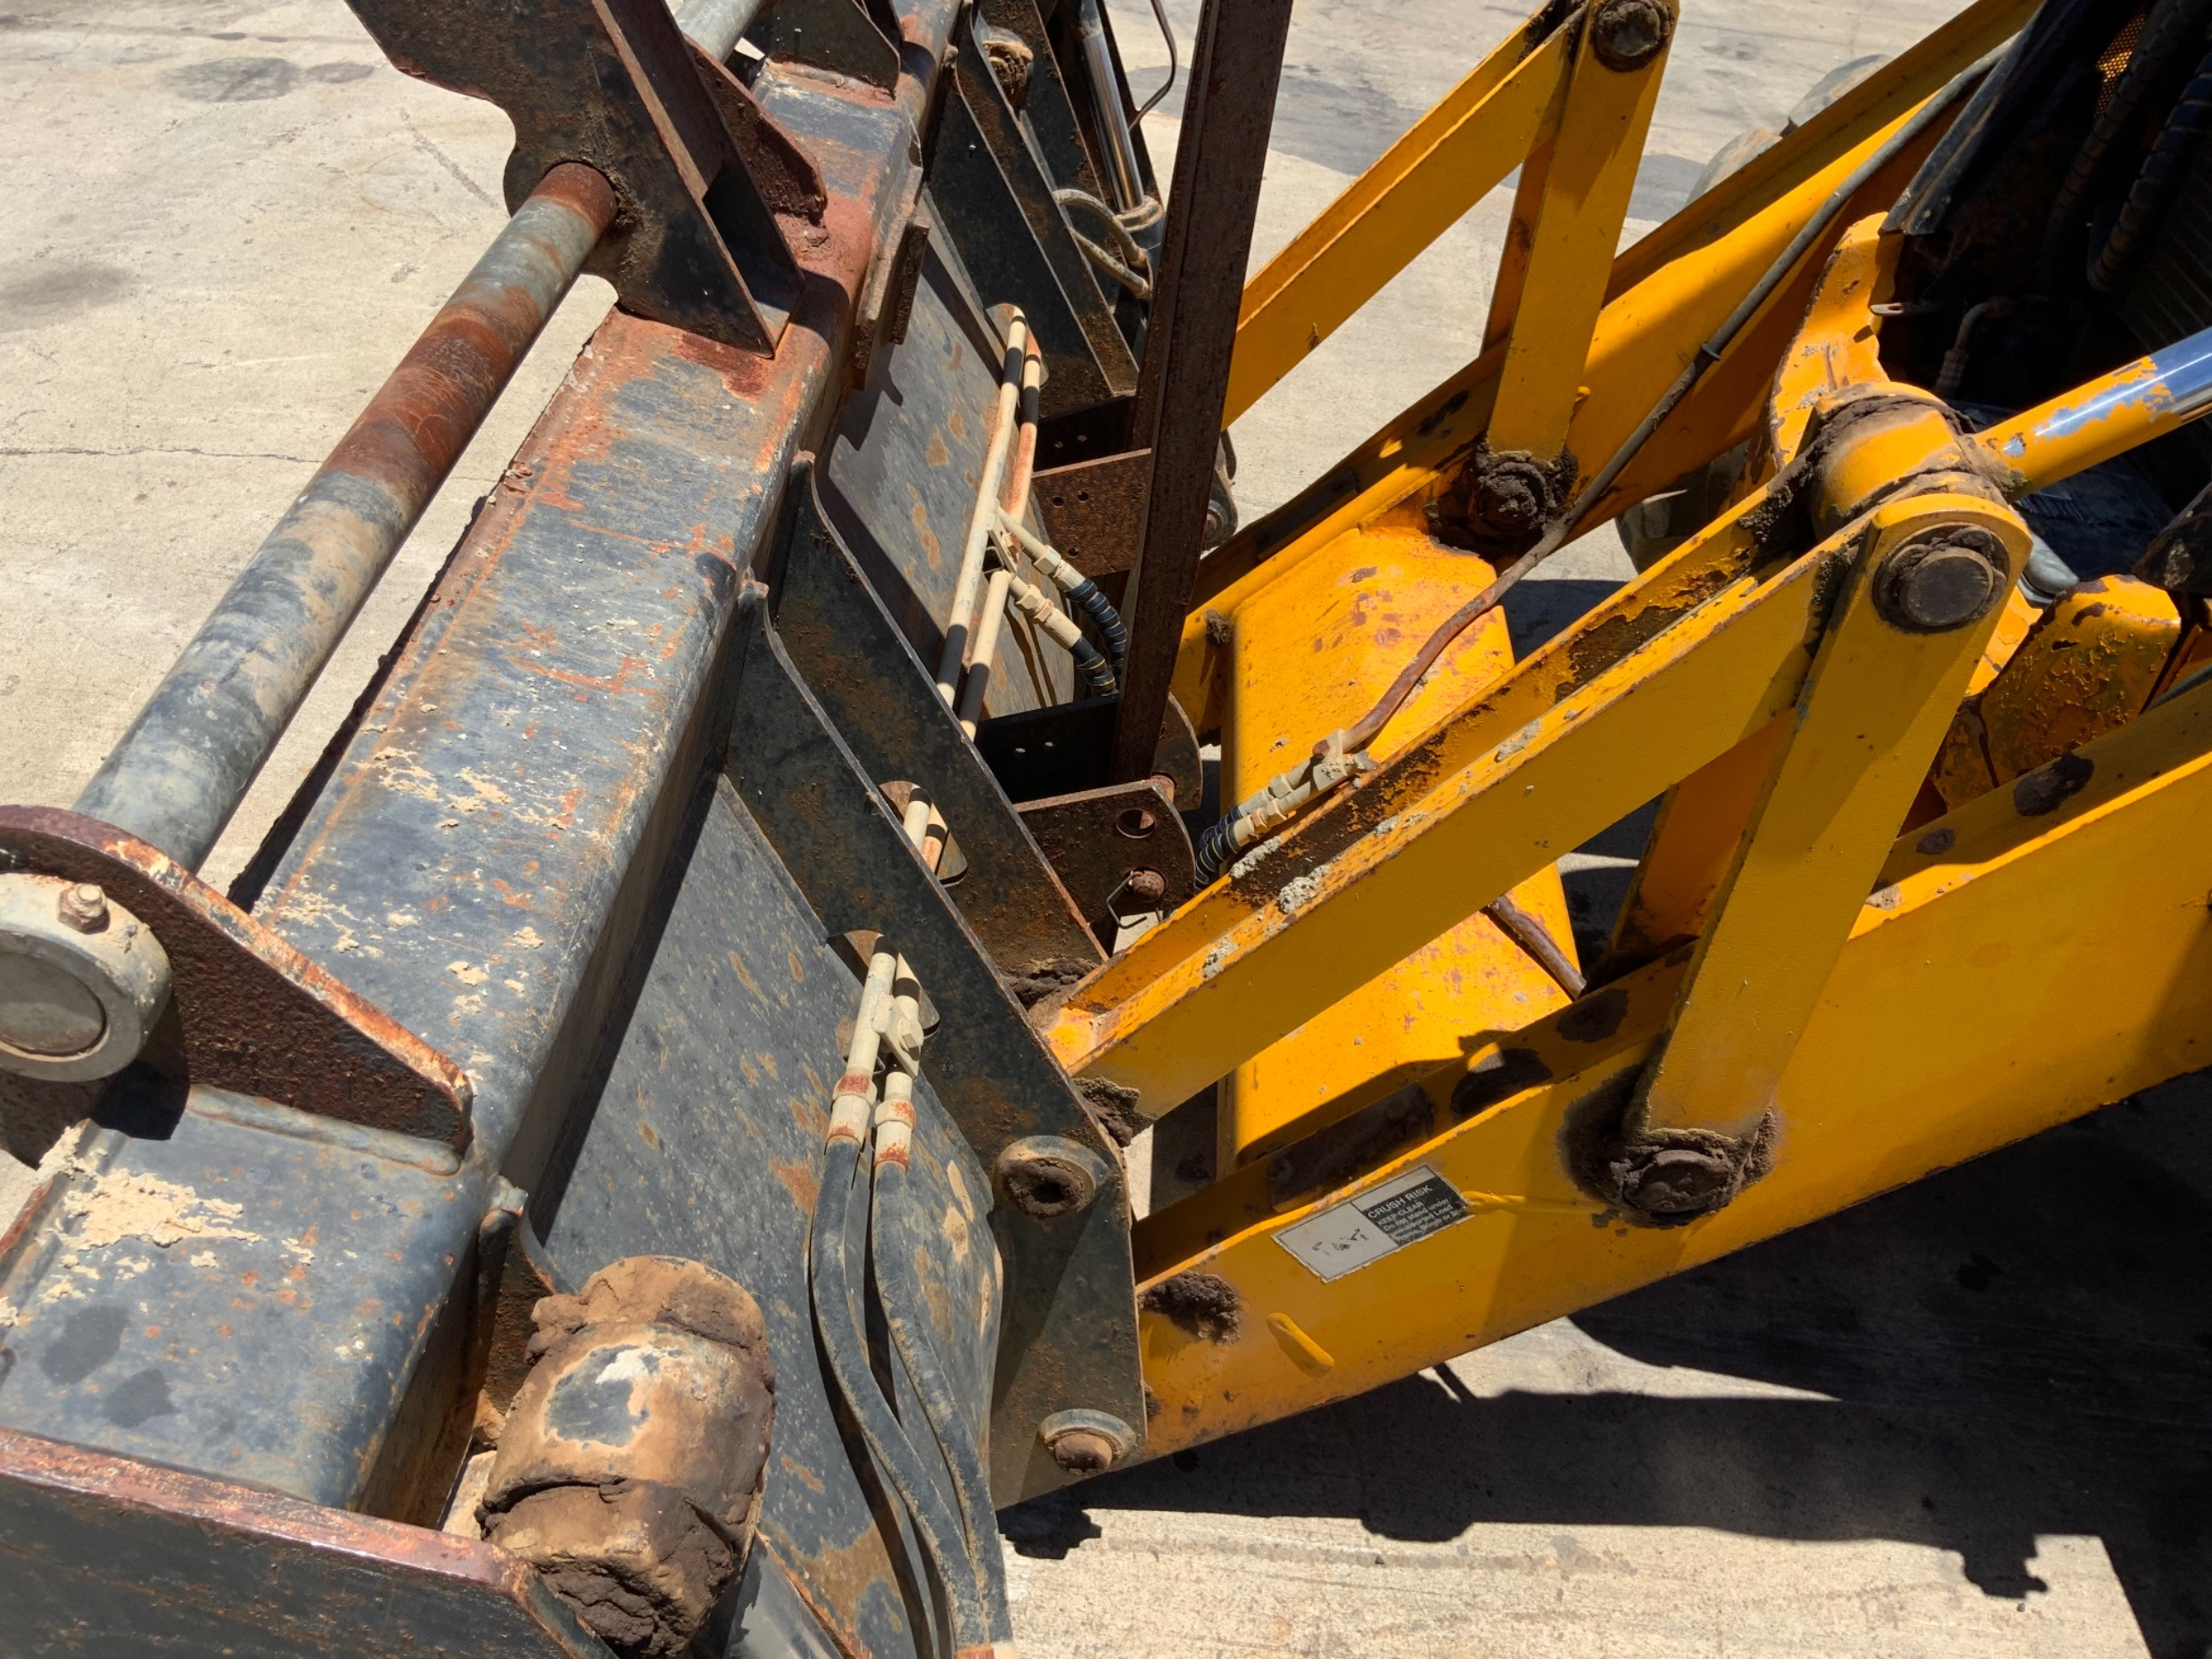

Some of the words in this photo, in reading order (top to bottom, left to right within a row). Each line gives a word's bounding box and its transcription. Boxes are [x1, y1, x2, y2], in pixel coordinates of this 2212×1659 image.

[1368, 1198, 1406, 1218] CRUSH
[1406, 1184, 1433, 1201] RISK
[1407, 1208, 1428, 1220] stand
[1428, 1198, 1449, 1210] under
[1433, 1204, 1454, 1217] Load
[1377, 1212, 1397, 1226] KEEP
[1398, 1201, 1424, 1217] CLEAR
